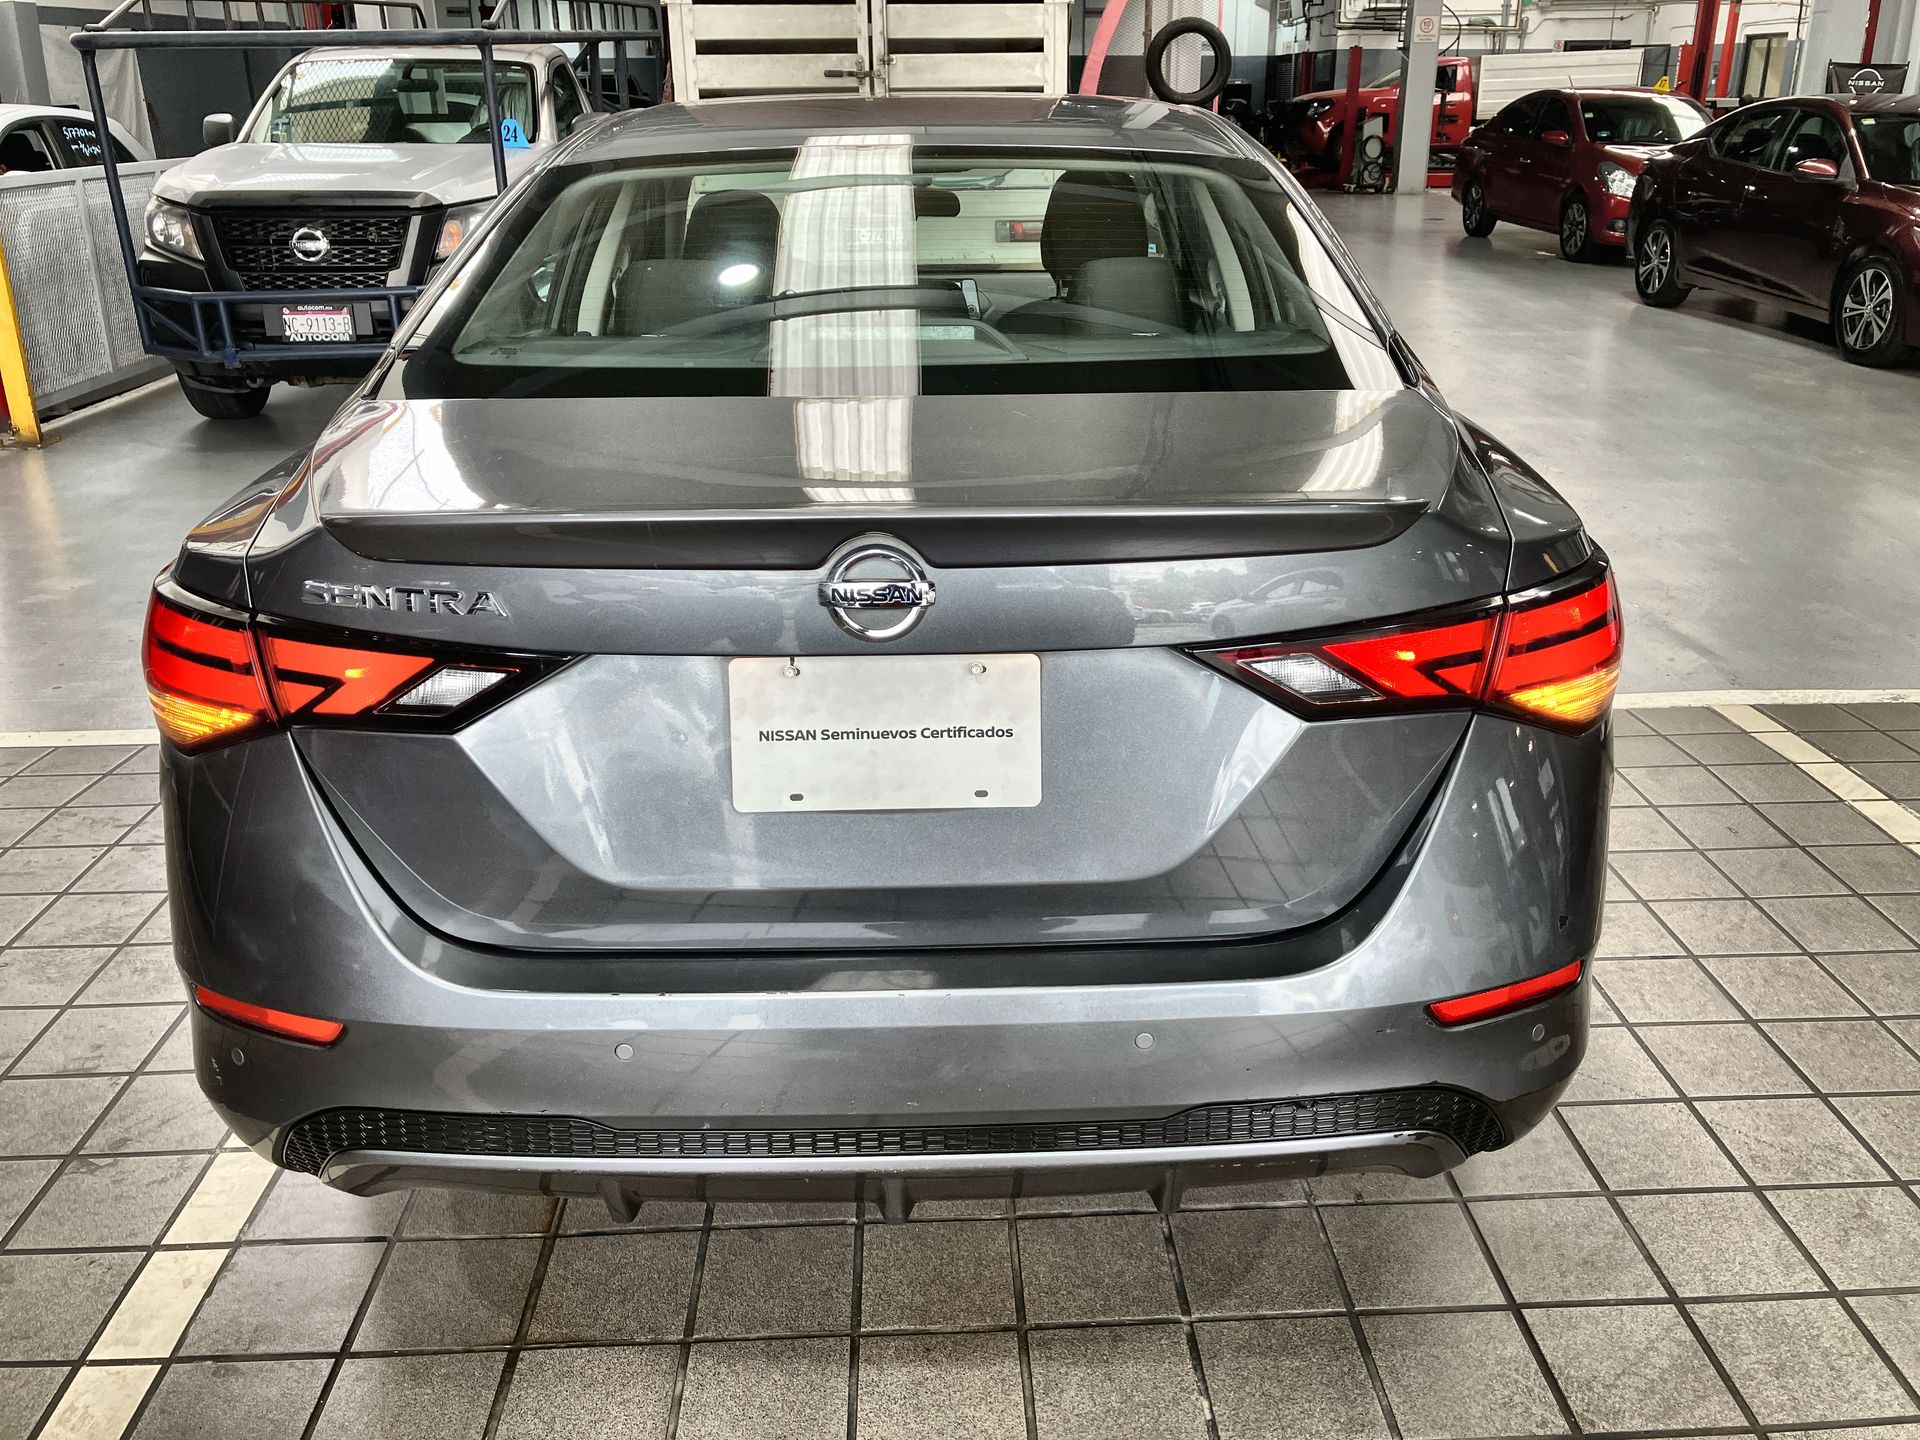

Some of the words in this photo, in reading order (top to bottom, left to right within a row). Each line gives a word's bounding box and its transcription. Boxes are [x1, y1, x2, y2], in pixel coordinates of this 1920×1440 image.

[503, 124, 518, 143] 24
[283, 316, 351, 333] NC-9113-B
[289, 332, 350, 342] AUTOCOM
[301, 580, 510, 617] SENTRA
[830, 586, 923, 604] NISSAN
[758, 729, 817, 742] NISSAN
[820, 727, 917, 741] Seminuevos
[920, 726, 1014, 739] Certificados
